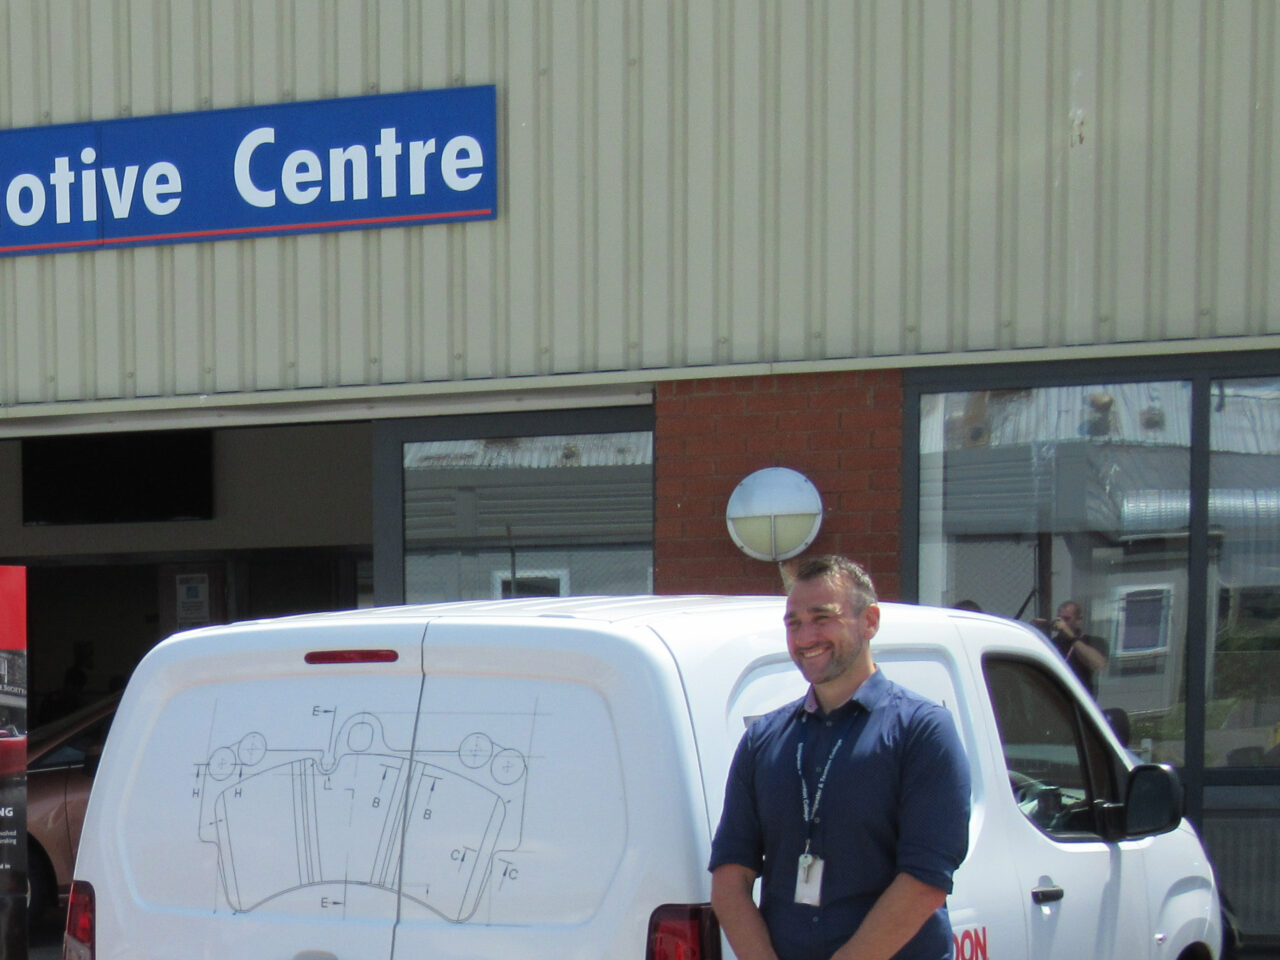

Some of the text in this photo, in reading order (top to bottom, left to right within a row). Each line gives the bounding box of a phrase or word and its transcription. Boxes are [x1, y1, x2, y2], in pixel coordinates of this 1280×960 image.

[233, 127, 484, 207] Centre
[312, 706, 321, 717] E
[192, 788, 432, 820] H H B B
[450, 849, 519, 881] C C
[321, 897, 329, 909] E
